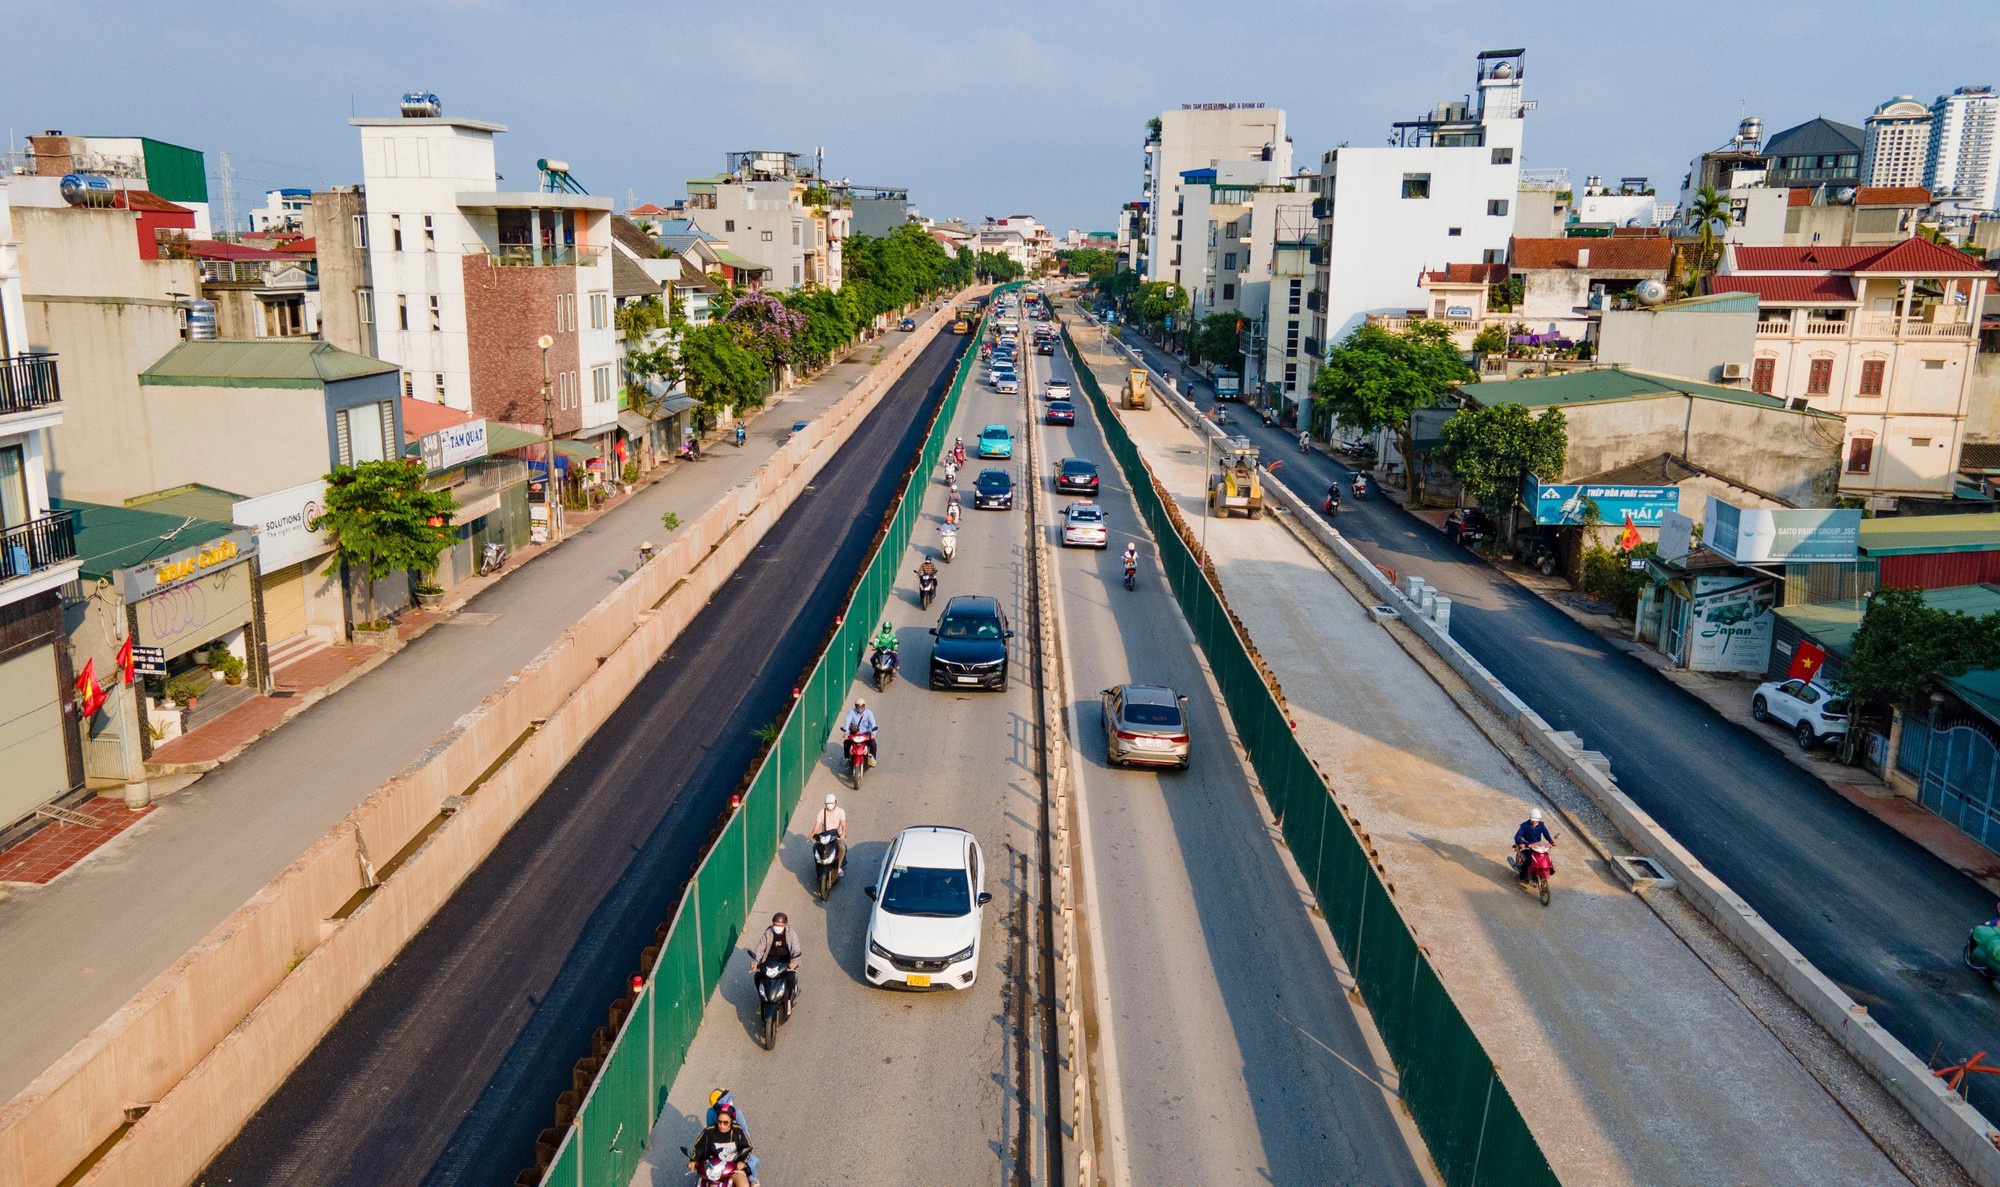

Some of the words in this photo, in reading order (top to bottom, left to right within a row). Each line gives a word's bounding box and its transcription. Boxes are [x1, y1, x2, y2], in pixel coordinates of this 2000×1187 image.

[1620, 507, 1652, 520] THÁI
[266, 513, 302, 531] SOLUTIONS
[1778, 528, 1797, 536] SAITO
[1798, 528, 1817, 536] PAINT
[1701, 624, 1752, 656] Japan
